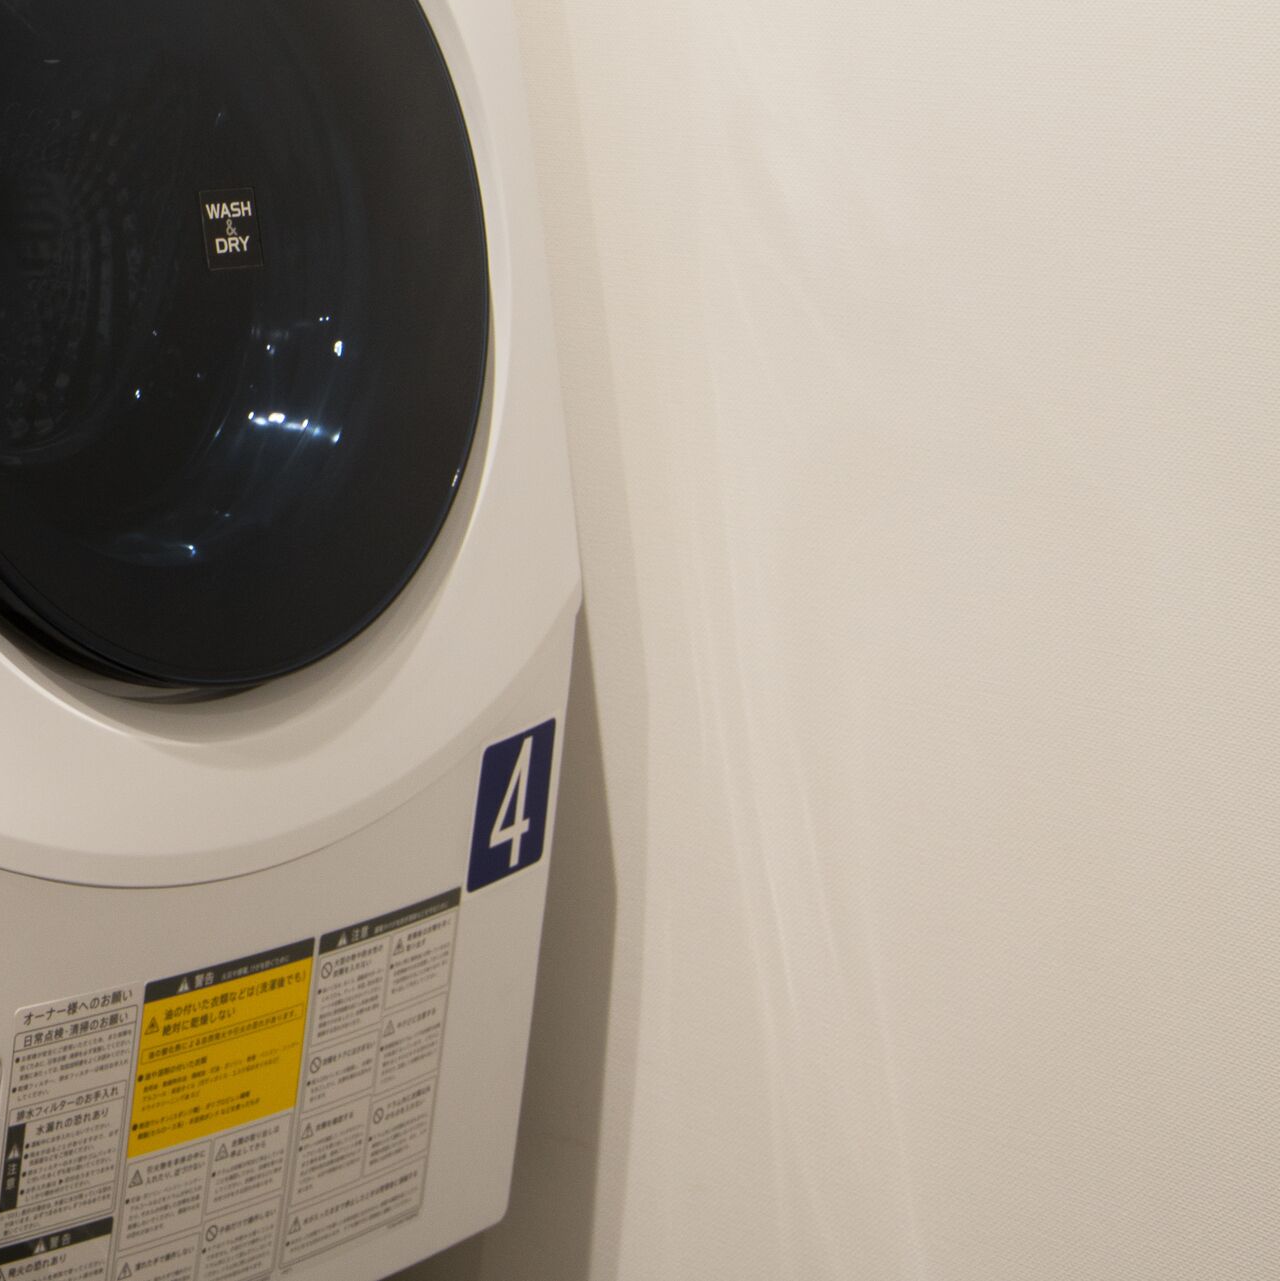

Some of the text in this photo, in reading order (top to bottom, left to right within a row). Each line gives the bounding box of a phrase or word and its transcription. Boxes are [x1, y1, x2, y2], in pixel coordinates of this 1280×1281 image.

[205, 200, 252, 220] WASH
[225, 218, 238, 236] &
[215, 235, 250, 254] DRY
[489, 735, 534, 868] 4
